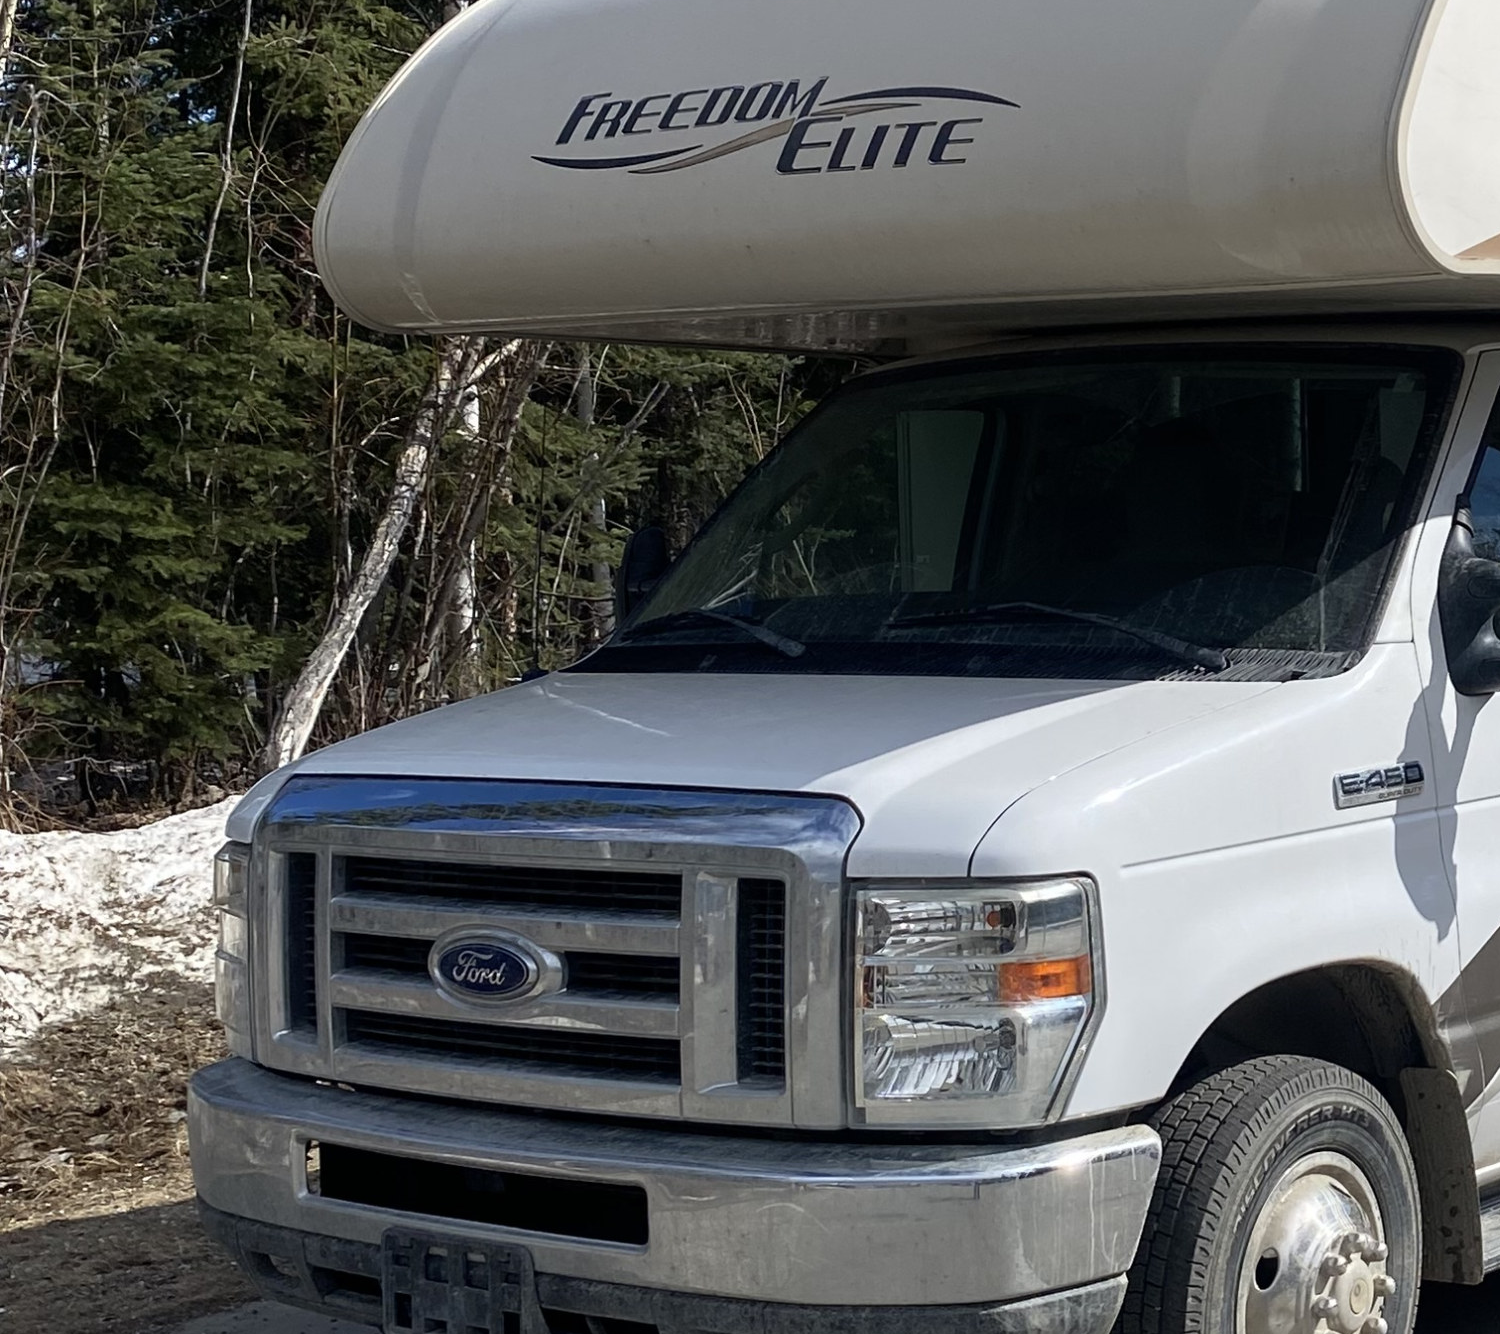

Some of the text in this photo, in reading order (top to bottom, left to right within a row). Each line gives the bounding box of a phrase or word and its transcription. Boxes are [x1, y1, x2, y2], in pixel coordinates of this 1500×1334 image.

[555, 76, 829, 144] FREEDOM
[776, 116, 983, 175] ELITE
[1340, 761, 1424, 794] E-450
[452, 950, 506, 985] Ford
